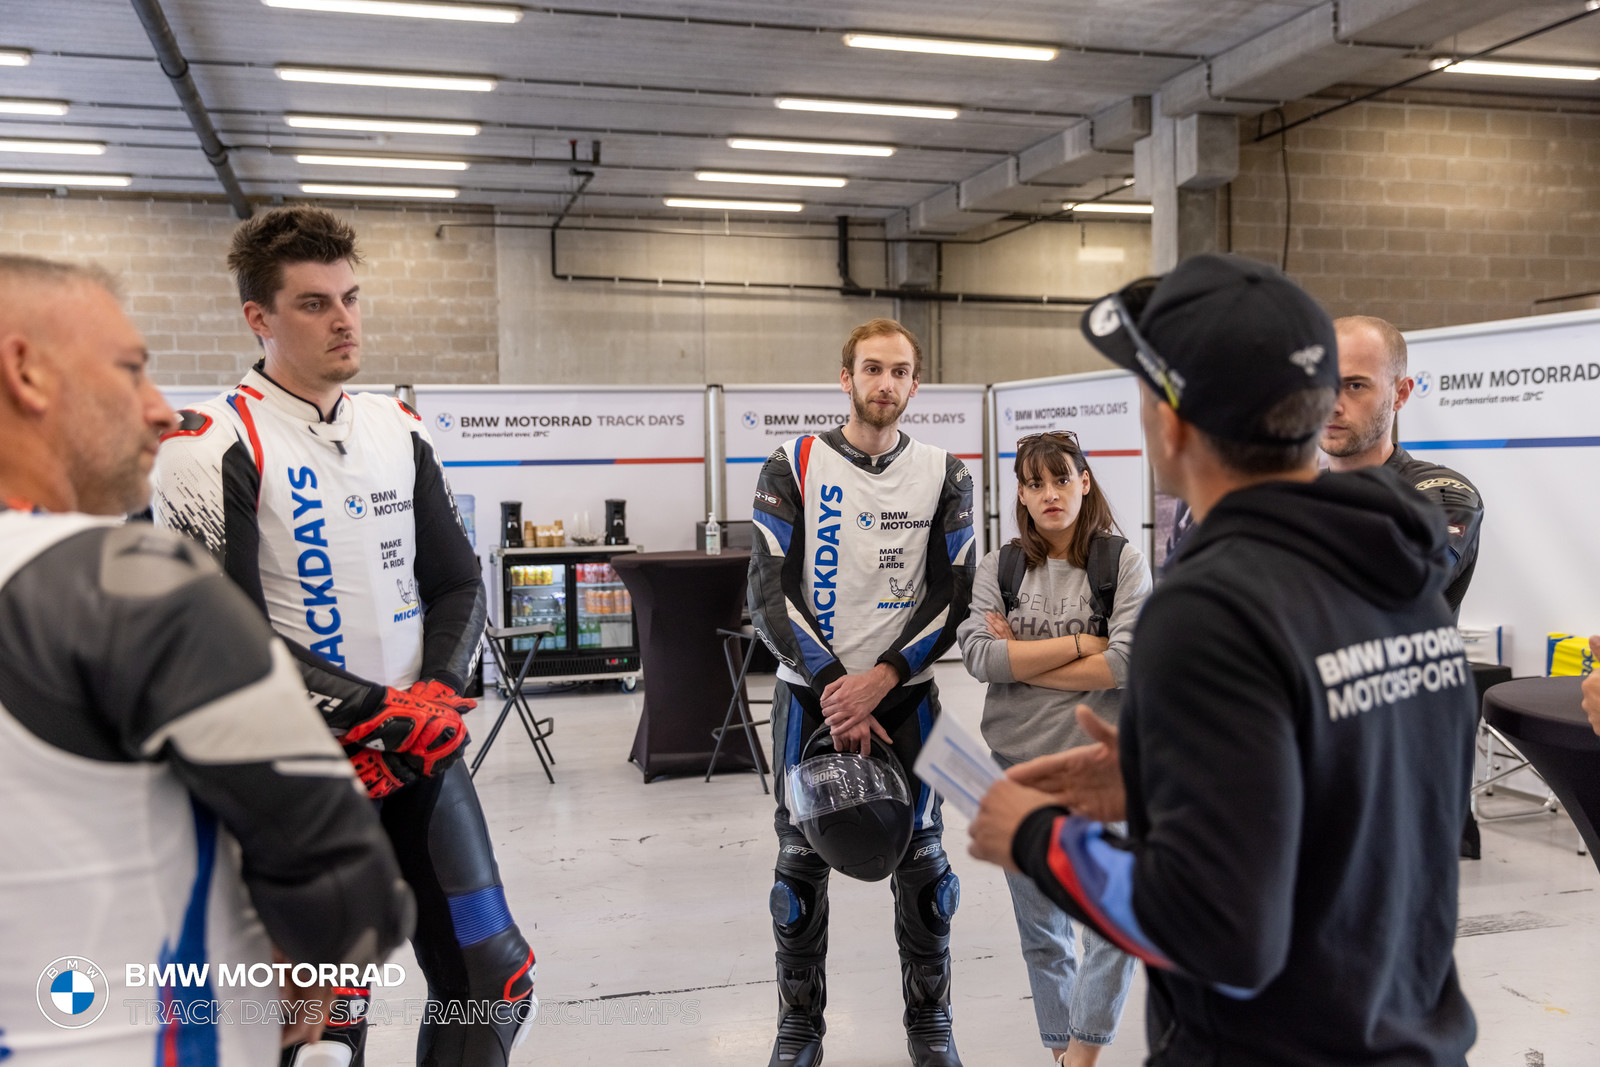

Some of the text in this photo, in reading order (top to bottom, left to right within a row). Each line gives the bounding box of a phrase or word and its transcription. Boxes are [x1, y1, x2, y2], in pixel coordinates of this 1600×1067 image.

[1439, 363, 1600, 391] BMW MOTORRAD
[1015, 402, 1128, 421] BMW MOTORRAD TRACK DAYS
[460, 415, 685, 427] BMW MOTORRAD TRACK DAYS
[764, 414, 799, 425] BMW
[932, 413, 966, 424] DAYS
[371, 489, 398, 503] BMW
[881, 511, 908, 521] BMW
[381, 539, 402, 550] MAKE
[382, 550, 397, 560] LIFE
[383, 558, 404, 569] A RIDE
[1010, 618, 1101, 639] CHATON
[1315, 638, 1386, 687] BMW
[811, 769, 840, 786] SHOEI
[782, 844, 817, 856] RST
[914, 843, 941, 860] RST
